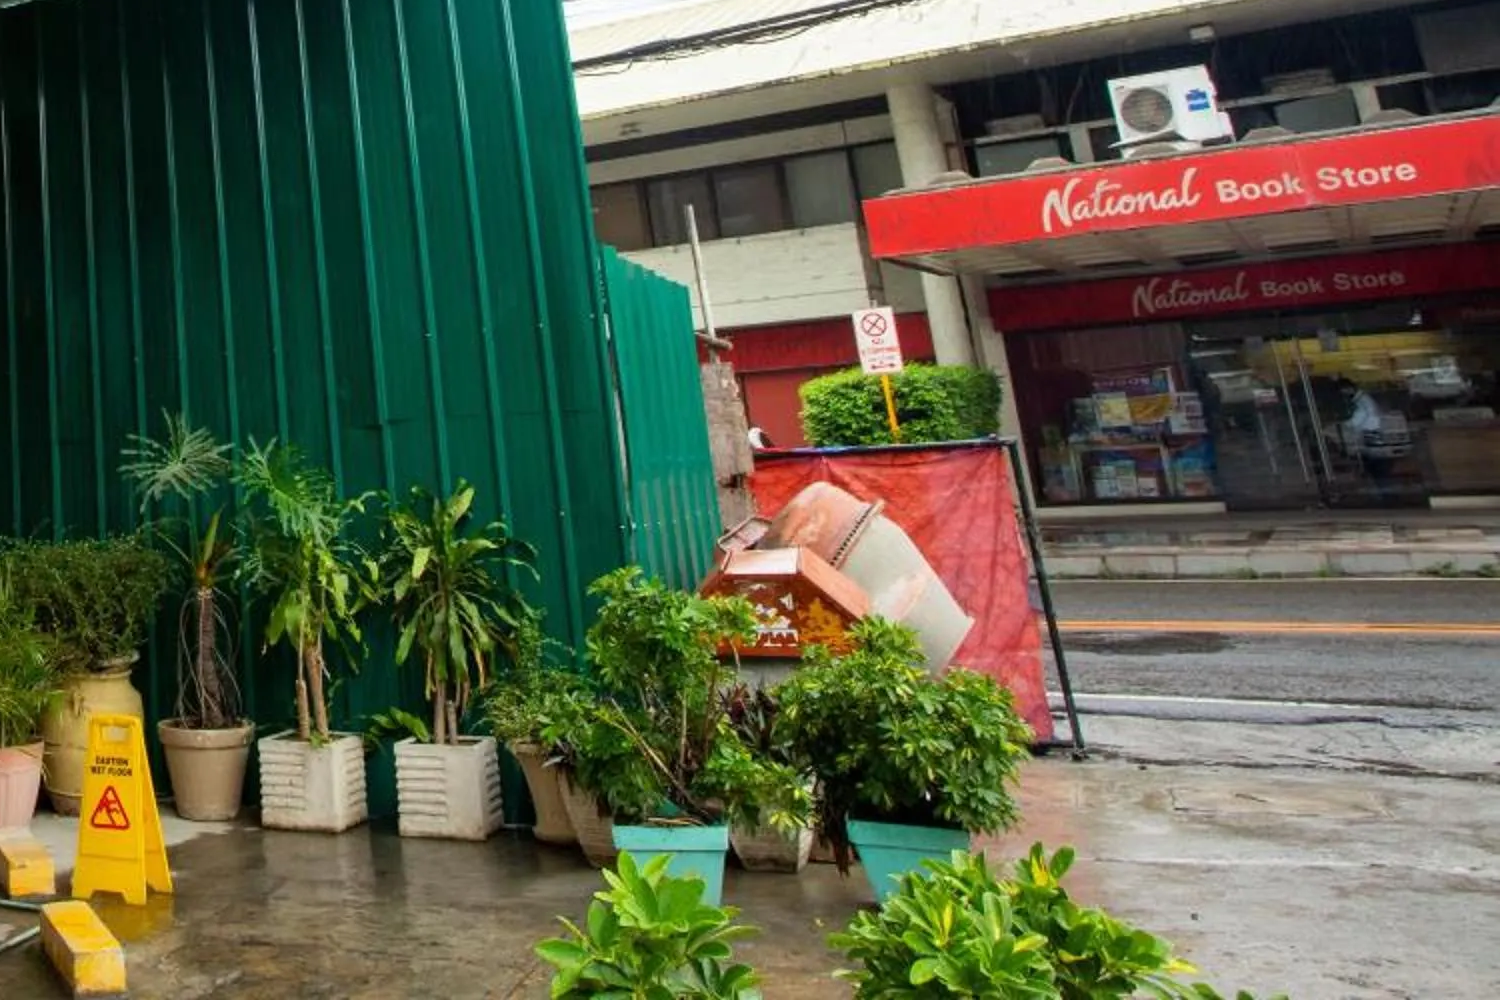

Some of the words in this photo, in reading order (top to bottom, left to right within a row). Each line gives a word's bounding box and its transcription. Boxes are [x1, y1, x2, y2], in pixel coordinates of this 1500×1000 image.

[1041, 167, 1202, 233] National
[1215, 174, 1304, 205] Book
[1316, 162, 1418, 191] Store
[1132, 270, 1250, 317] National
[1260, 275, 1325, 298] Book
[1333, 269, 1407, 291] Store
[91, 765, 107, 775] WET
[107, 767, 133, 777] FLOOR
[95, 755, 129, 767] CAUTION
